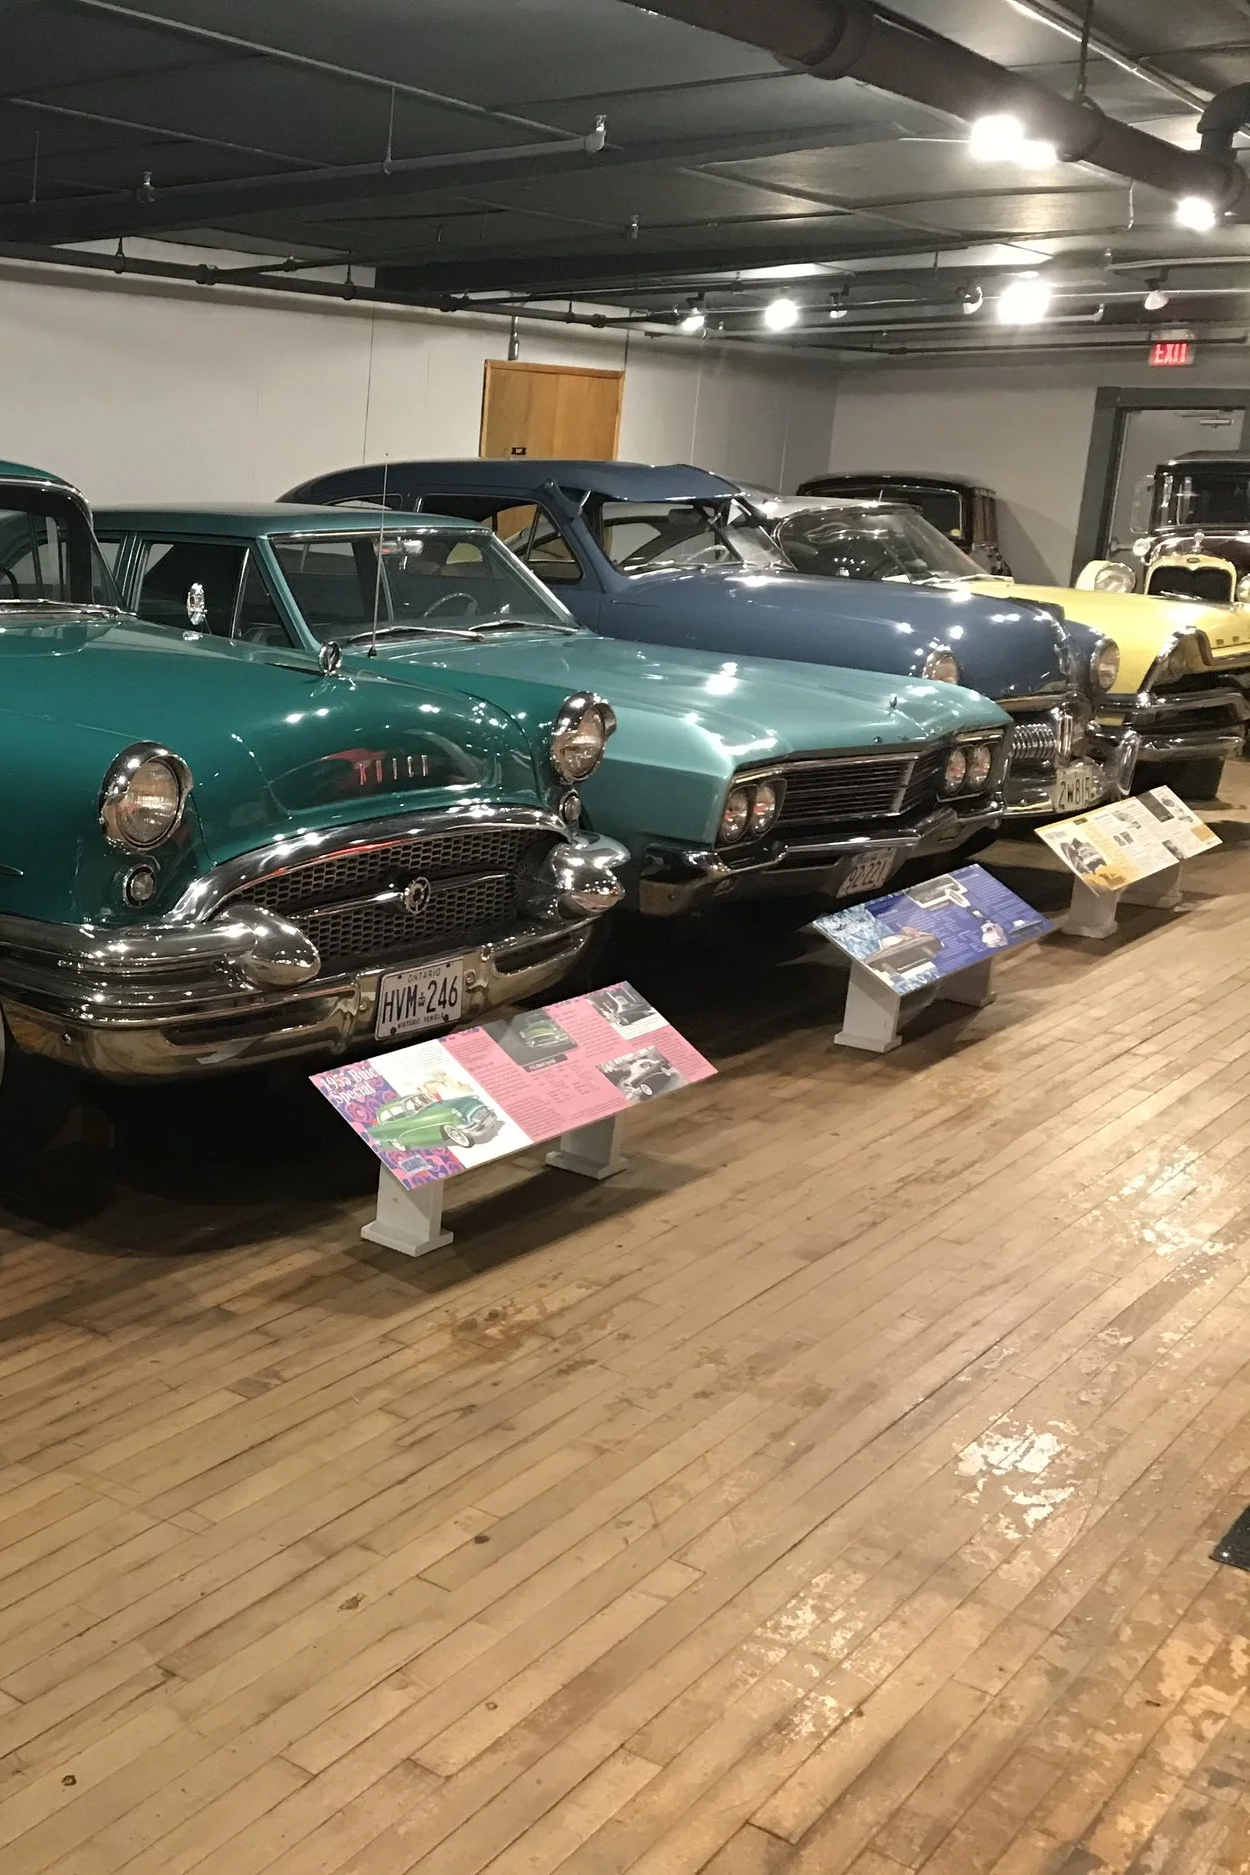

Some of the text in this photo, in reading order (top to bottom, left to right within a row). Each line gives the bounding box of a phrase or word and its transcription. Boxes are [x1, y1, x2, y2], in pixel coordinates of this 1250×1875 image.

[1154, 343, 1187, 363] EXIT
[407, 968, 441, 983] ONTARIO
[320, 1072, 352, 1091] 1955
[330, 1081, 377, 1105] Special
